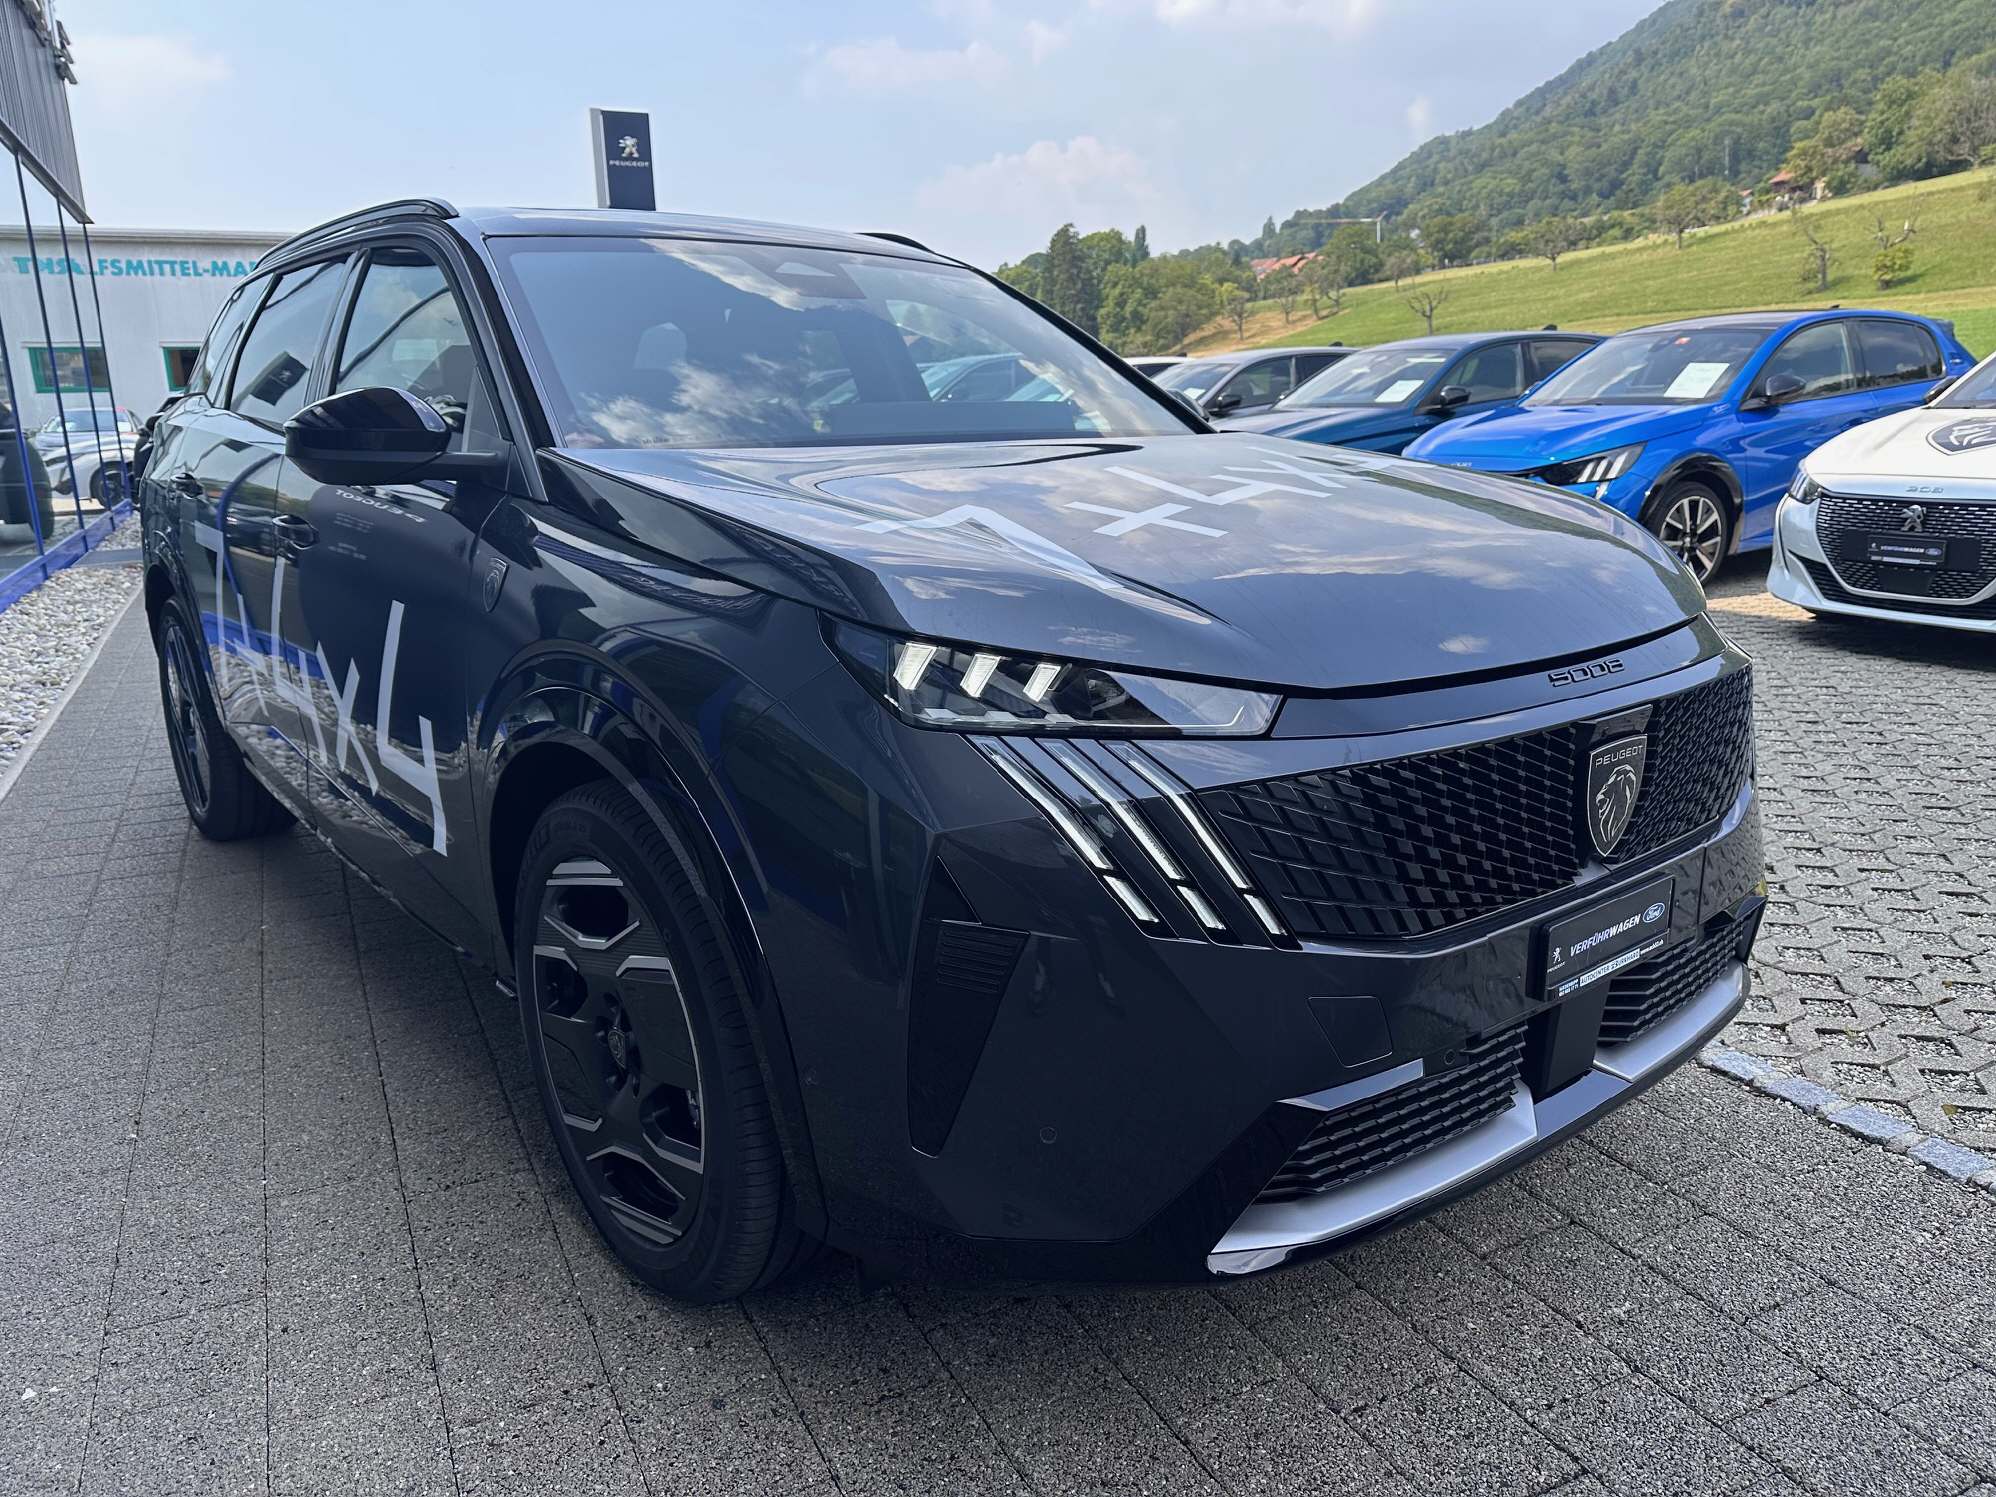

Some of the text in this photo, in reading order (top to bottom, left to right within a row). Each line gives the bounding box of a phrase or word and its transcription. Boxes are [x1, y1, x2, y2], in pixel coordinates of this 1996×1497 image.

[609, 160, 649, 168] PEUGEOT
[1548, 659, 1624, 687] 5008
[1595, 745, 1644, 767] PEUGEOT
[1570, 904, 1664, 957] VERFÜHRWAGEN Ford
